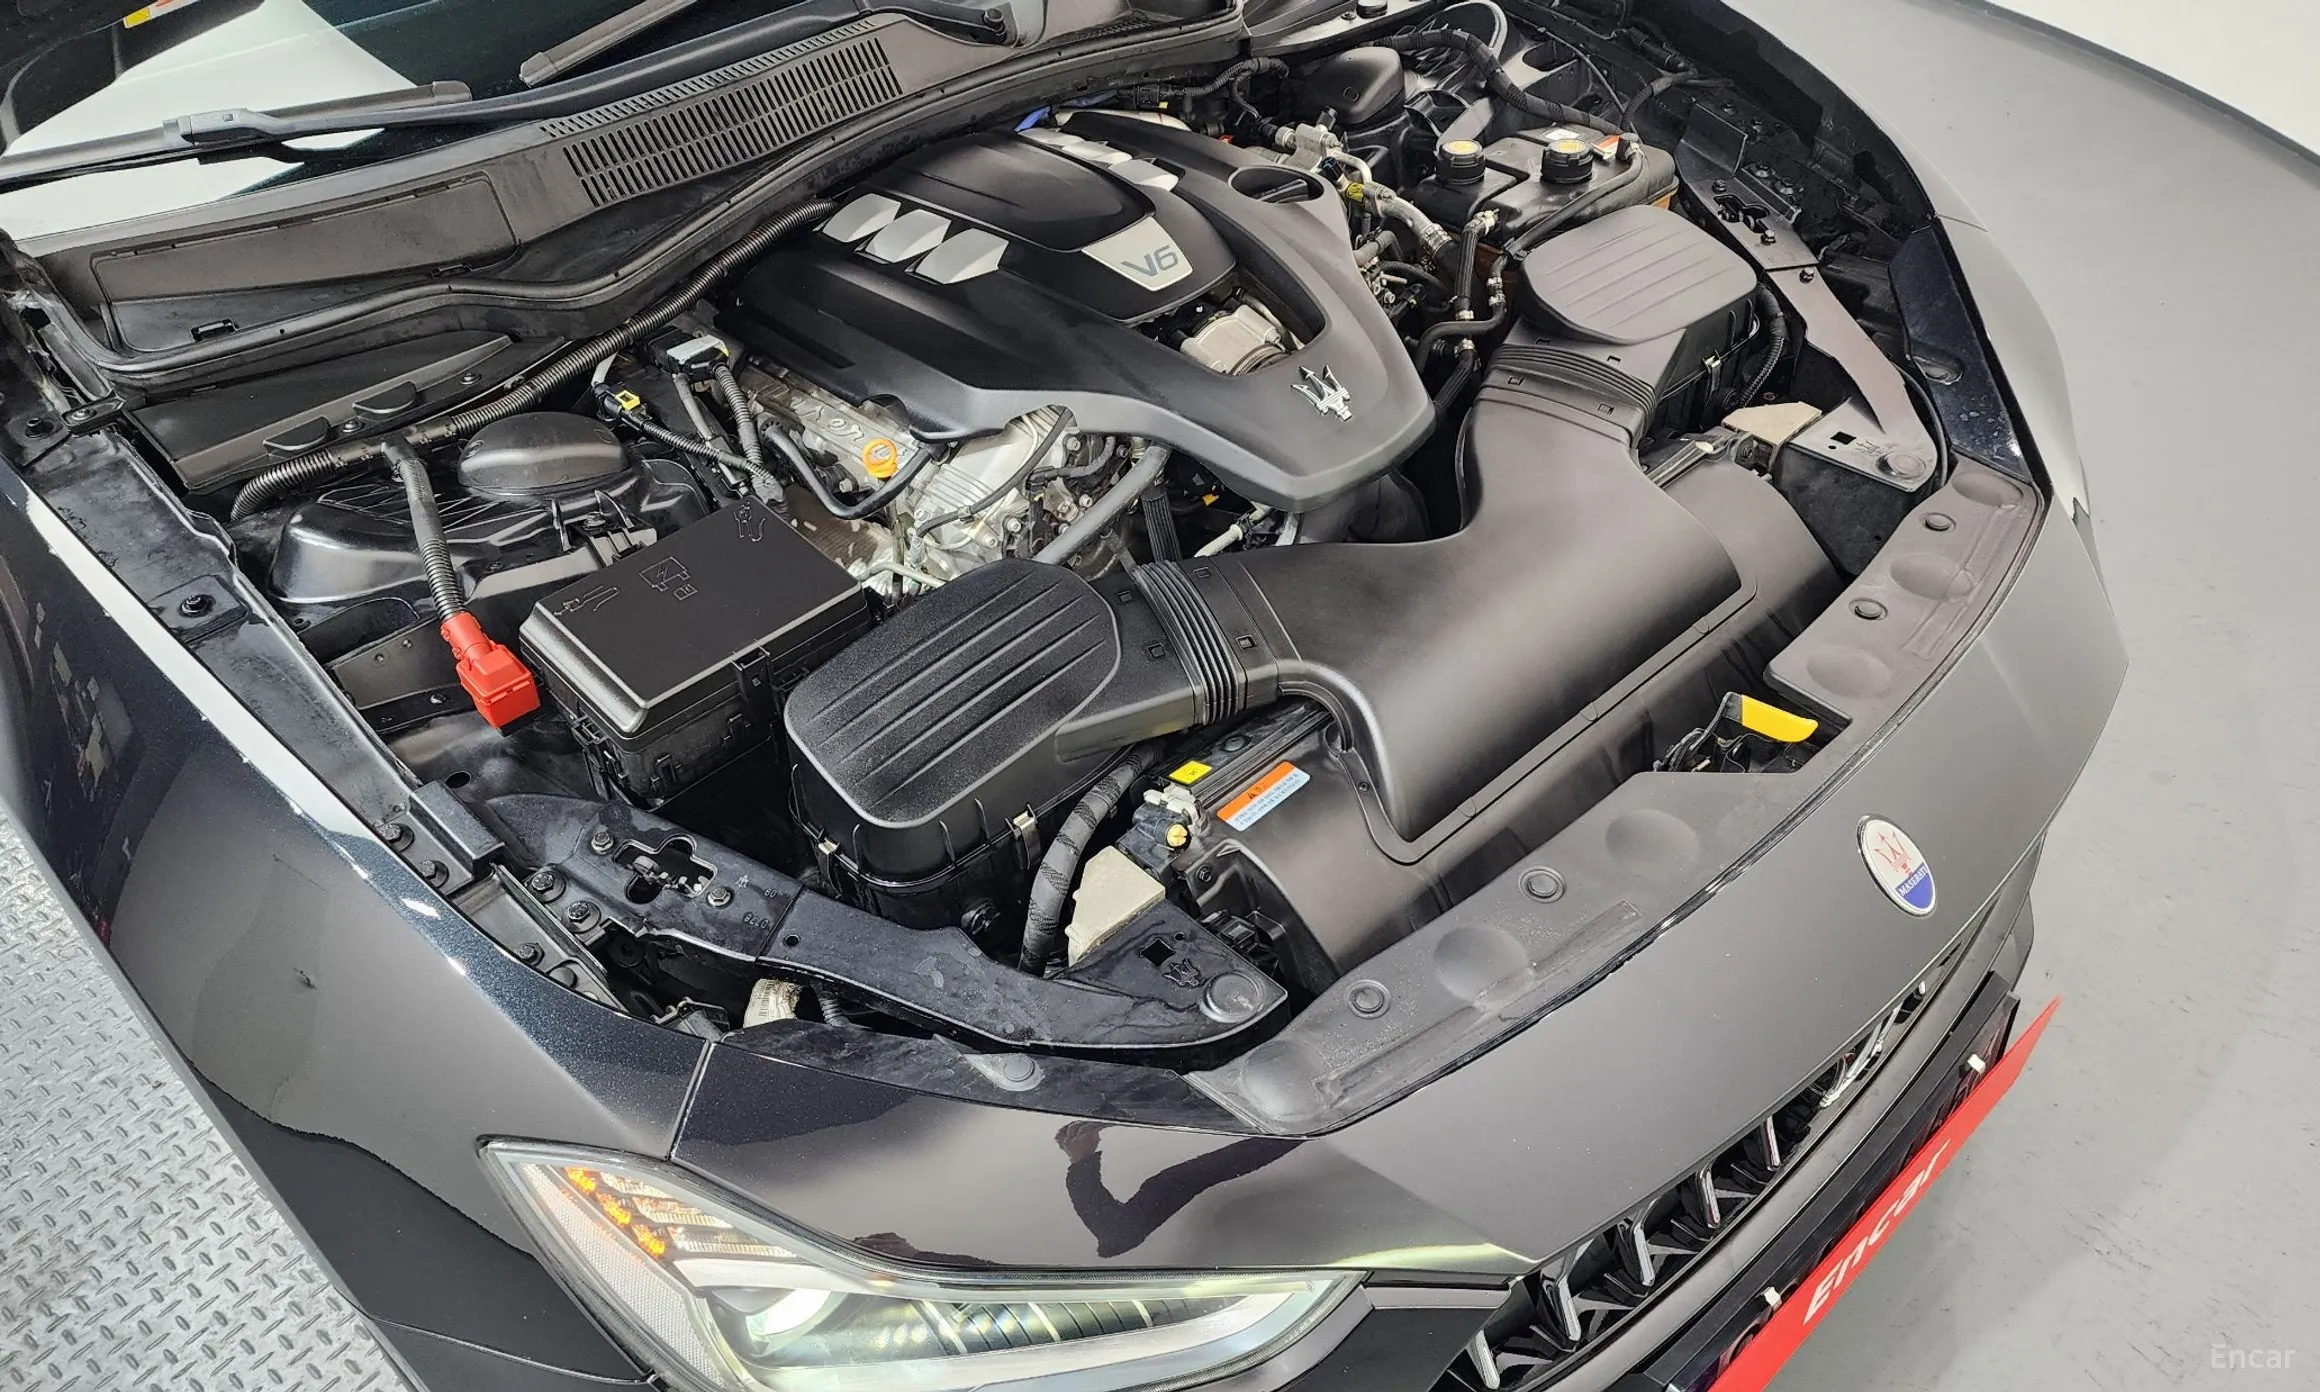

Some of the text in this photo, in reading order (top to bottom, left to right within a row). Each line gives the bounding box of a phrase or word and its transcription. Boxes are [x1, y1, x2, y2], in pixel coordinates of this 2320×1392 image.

[1120, 244, 1179, 277] V6
[1898, 865, 1929, 897] MASERATI
[1803, 1138, 1951, 1326] Encar
